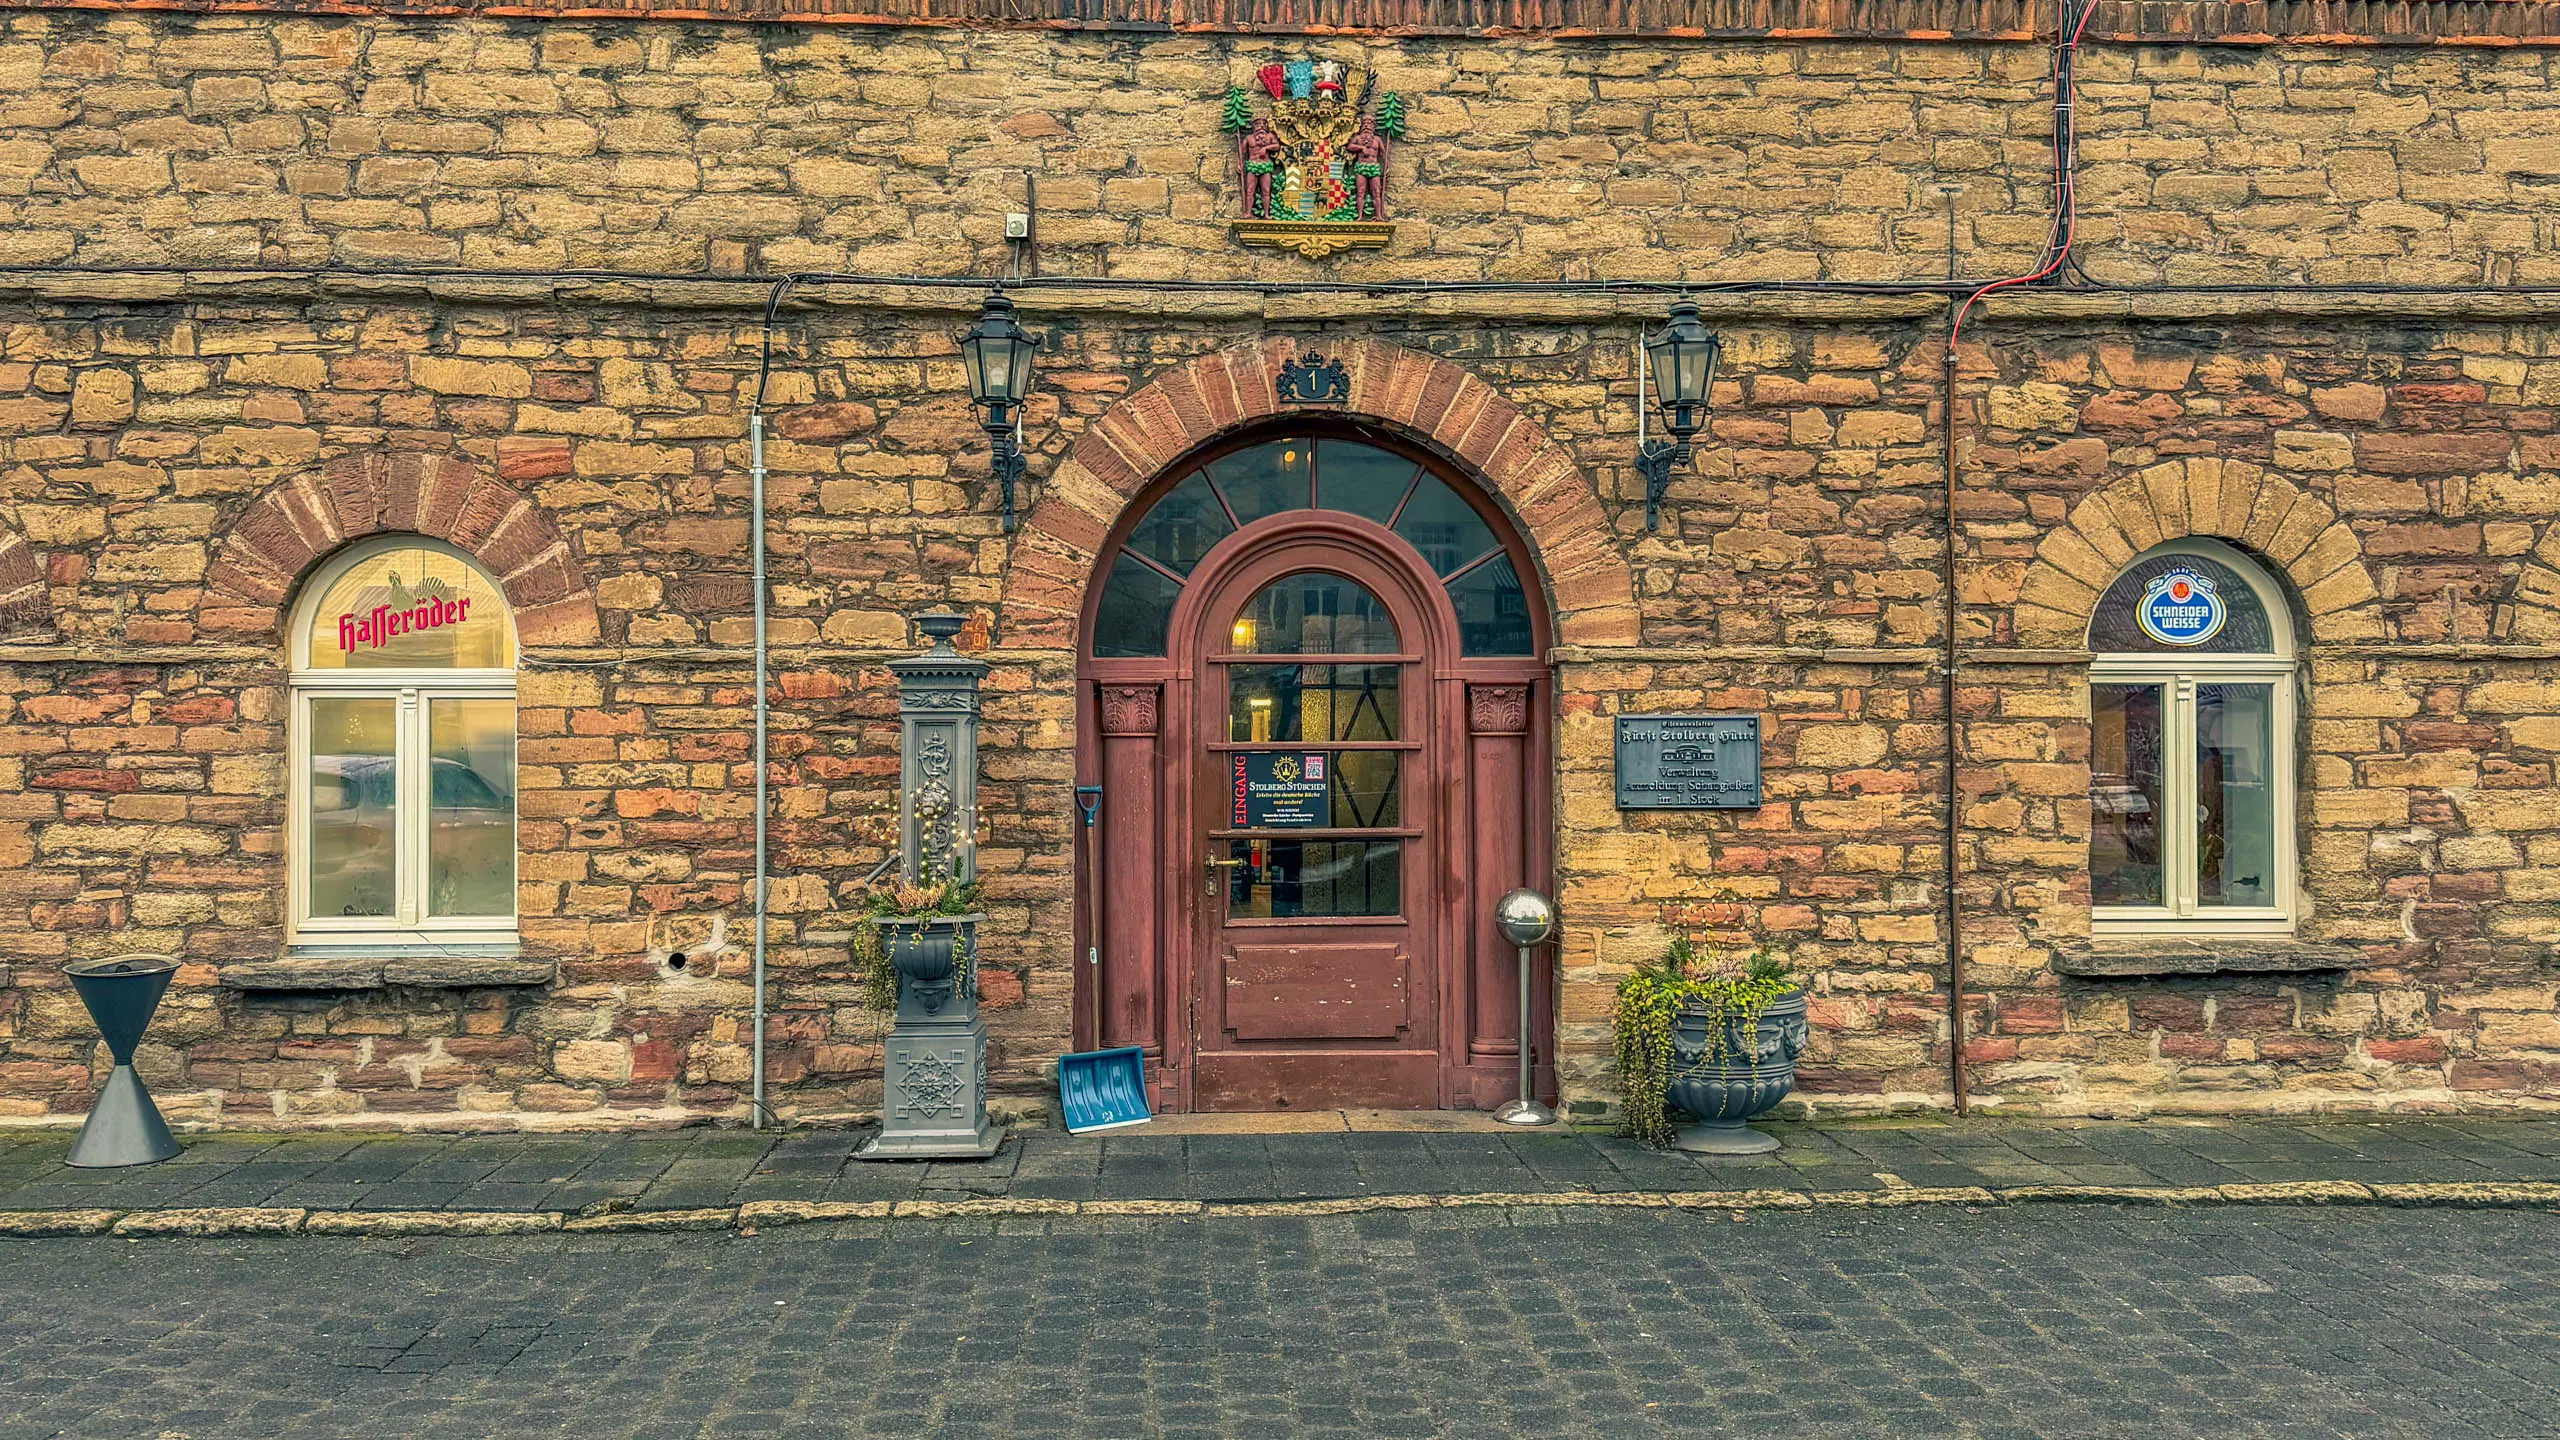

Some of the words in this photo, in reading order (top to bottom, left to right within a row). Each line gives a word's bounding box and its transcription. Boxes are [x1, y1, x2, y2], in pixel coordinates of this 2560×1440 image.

[1308, 370, 1316, 391] 1
[2152, 606, 2209, 617] SCHNEIDER
[338, 594, 471, 654] Hasseröder
[2161, 618, 2201, 628] WEISSE
[1621, 730, 1656, 744] Fürst
[1660, 730, 1716, 744] Stolberg
[1719, 730, 1755, 744] Hütte
[1658, 767, 1719, 779] Verwaltung
[1234, 756, 1247, 825] EINGANG
[1623, 780, 1685, 793] Anmeldung
[1657, 794, 1672, 804] im
[1690, 794, 1720, 805] Stock
